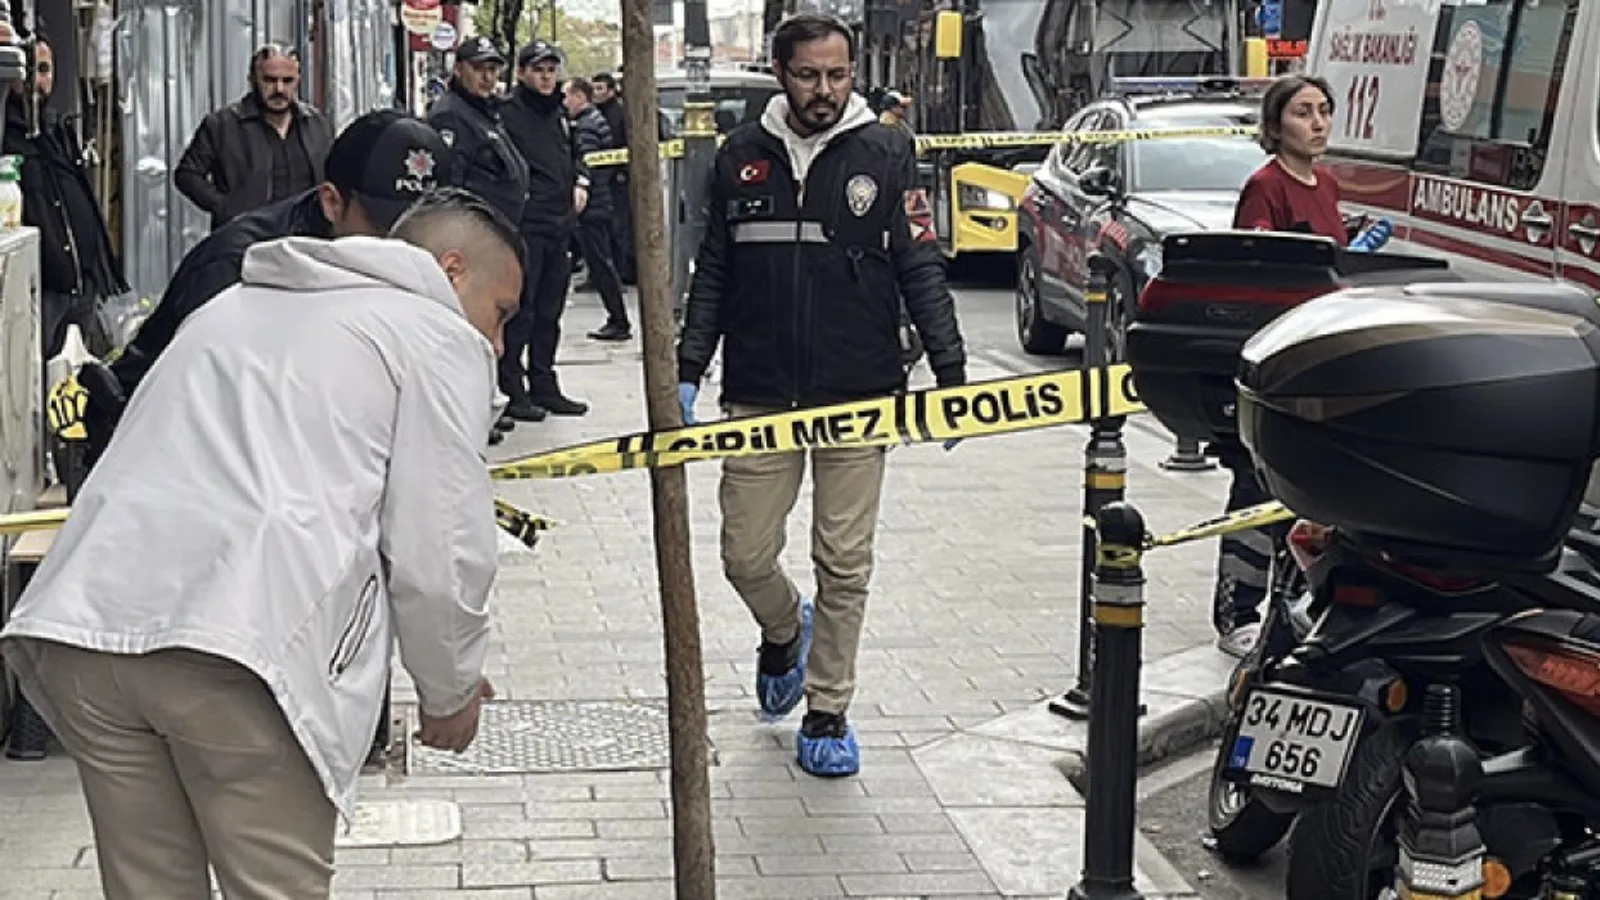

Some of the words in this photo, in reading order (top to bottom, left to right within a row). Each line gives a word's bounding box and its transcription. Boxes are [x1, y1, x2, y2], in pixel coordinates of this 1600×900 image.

[1345, 76, 1380, 139] 112
[1414, 178, 1518, 232] AMBULANS
[1247, 696, 1281, 730] 34
[1286, 702, 1353, 741] MDJ
[1265, 741, 1320, 777] 656
